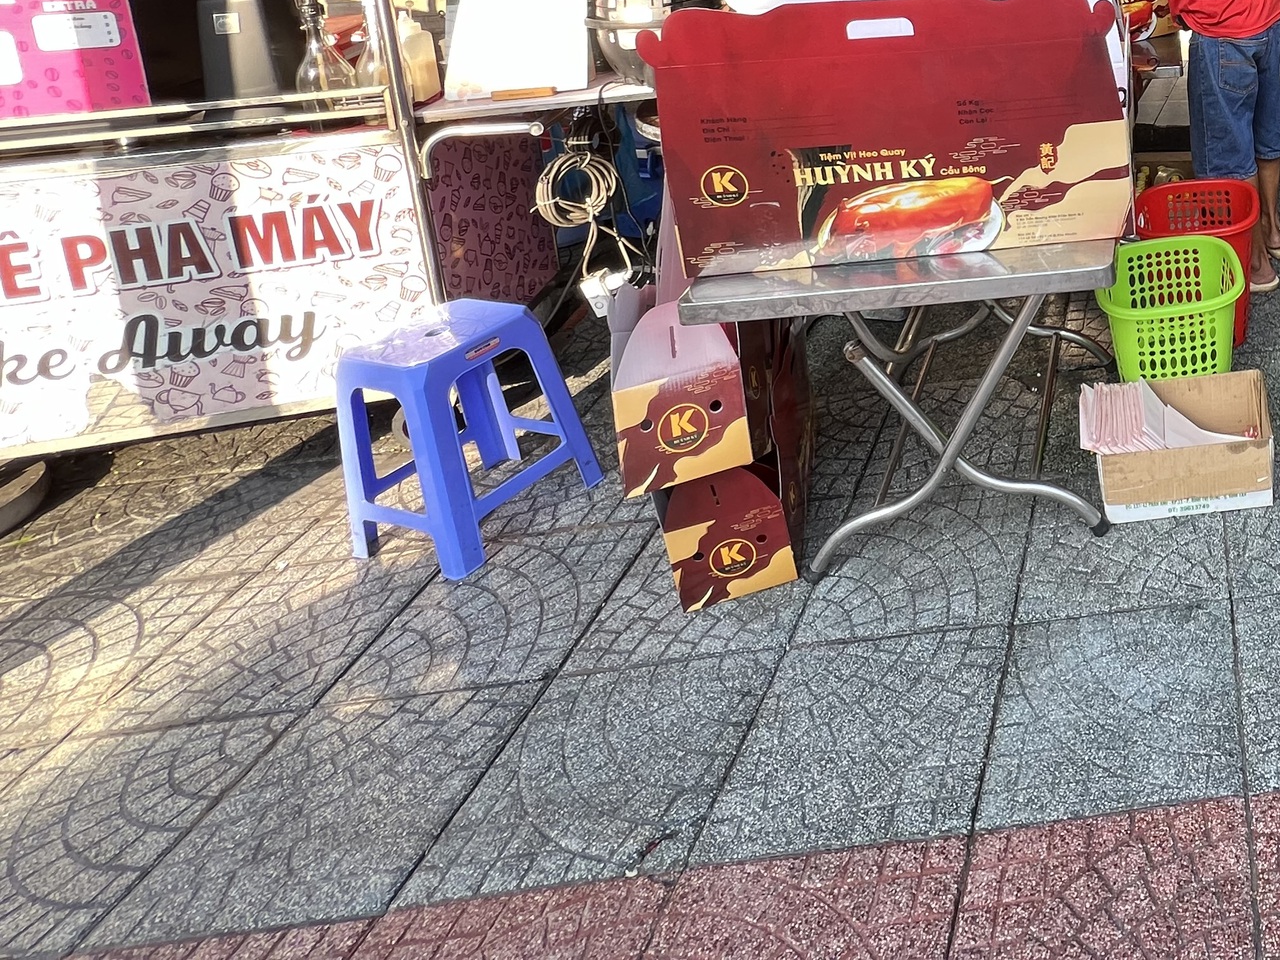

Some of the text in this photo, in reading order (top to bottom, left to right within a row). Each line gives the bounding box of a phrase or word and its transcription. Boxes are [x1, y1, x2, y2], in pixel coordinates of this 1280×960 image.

[42, 0, 97, 12] TRA
[819, 147, 906, 162] Tiệm Vịt Heo Quay
[711, 171, 738, 193] K
[792, 159, 896, 188] HUỲNH
[900, 152, 937, 180] KÝ
[962, 164, 987, 176] Bông
[61, 221, 215, 296] PHA
[230, 194, 377, 270] MÁY
[101, 310, 326, 375] Away
[670, 408, 697, 438] K
[720, 542, 746, 566] K
